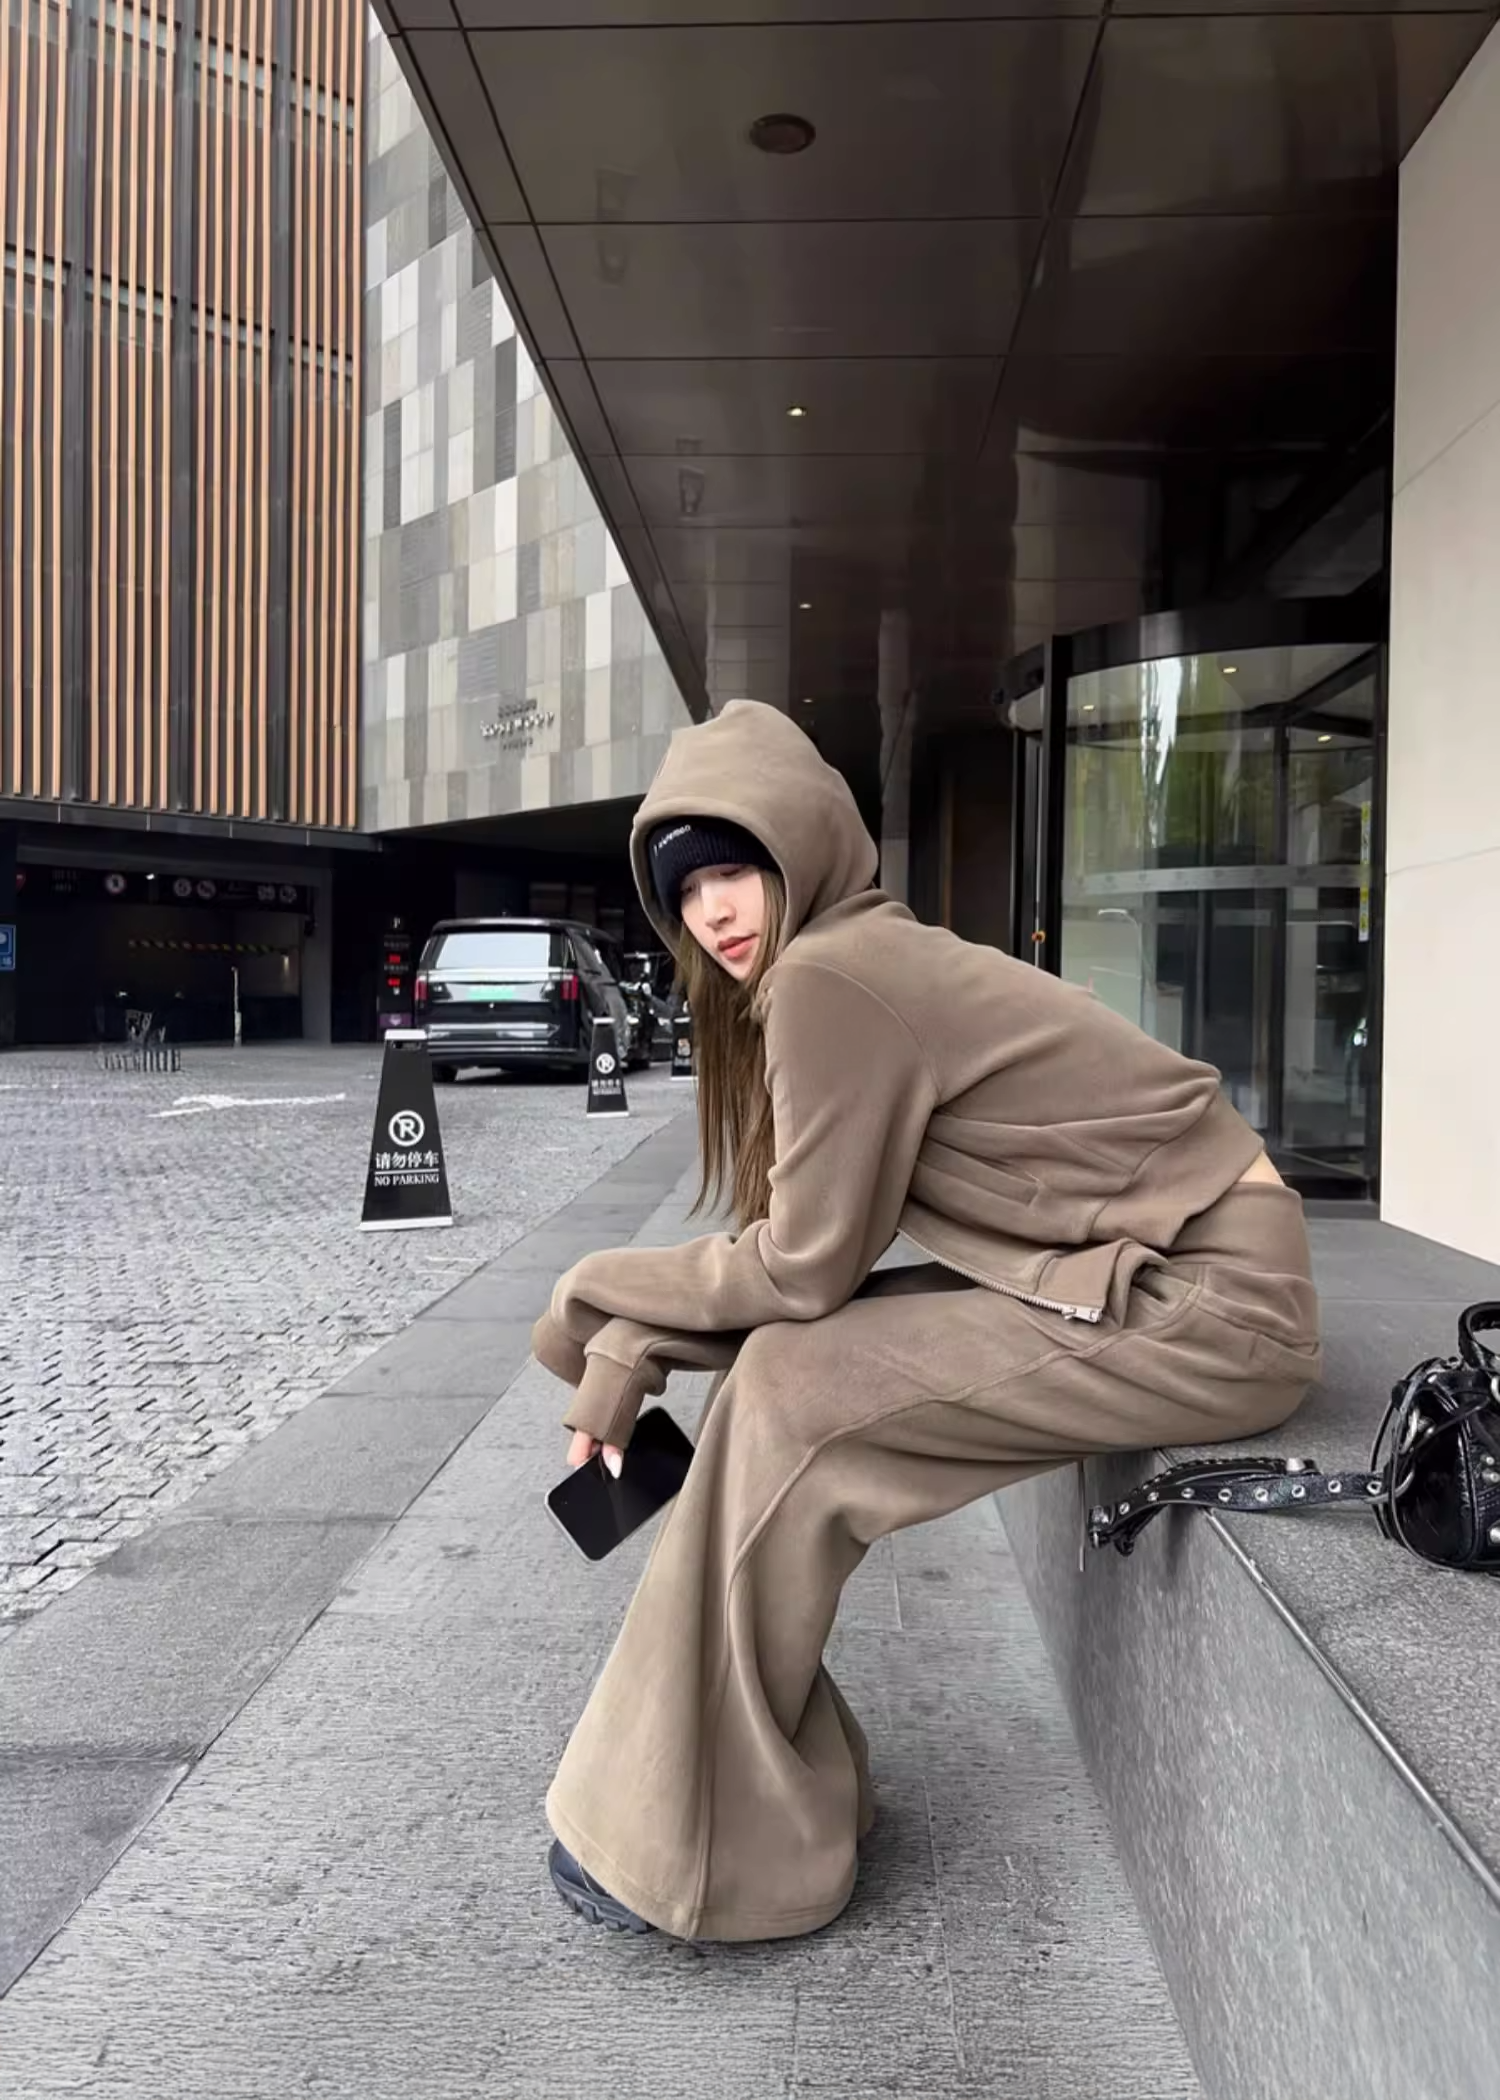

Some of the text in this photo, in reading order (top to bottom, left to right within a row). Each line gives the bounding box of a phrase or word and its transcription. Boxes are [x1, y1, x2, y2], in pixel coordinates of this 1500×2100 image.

[375, 1150, 439, 1170] 请勿停车
[374, 1172, 439, 1187] NO PARKING
